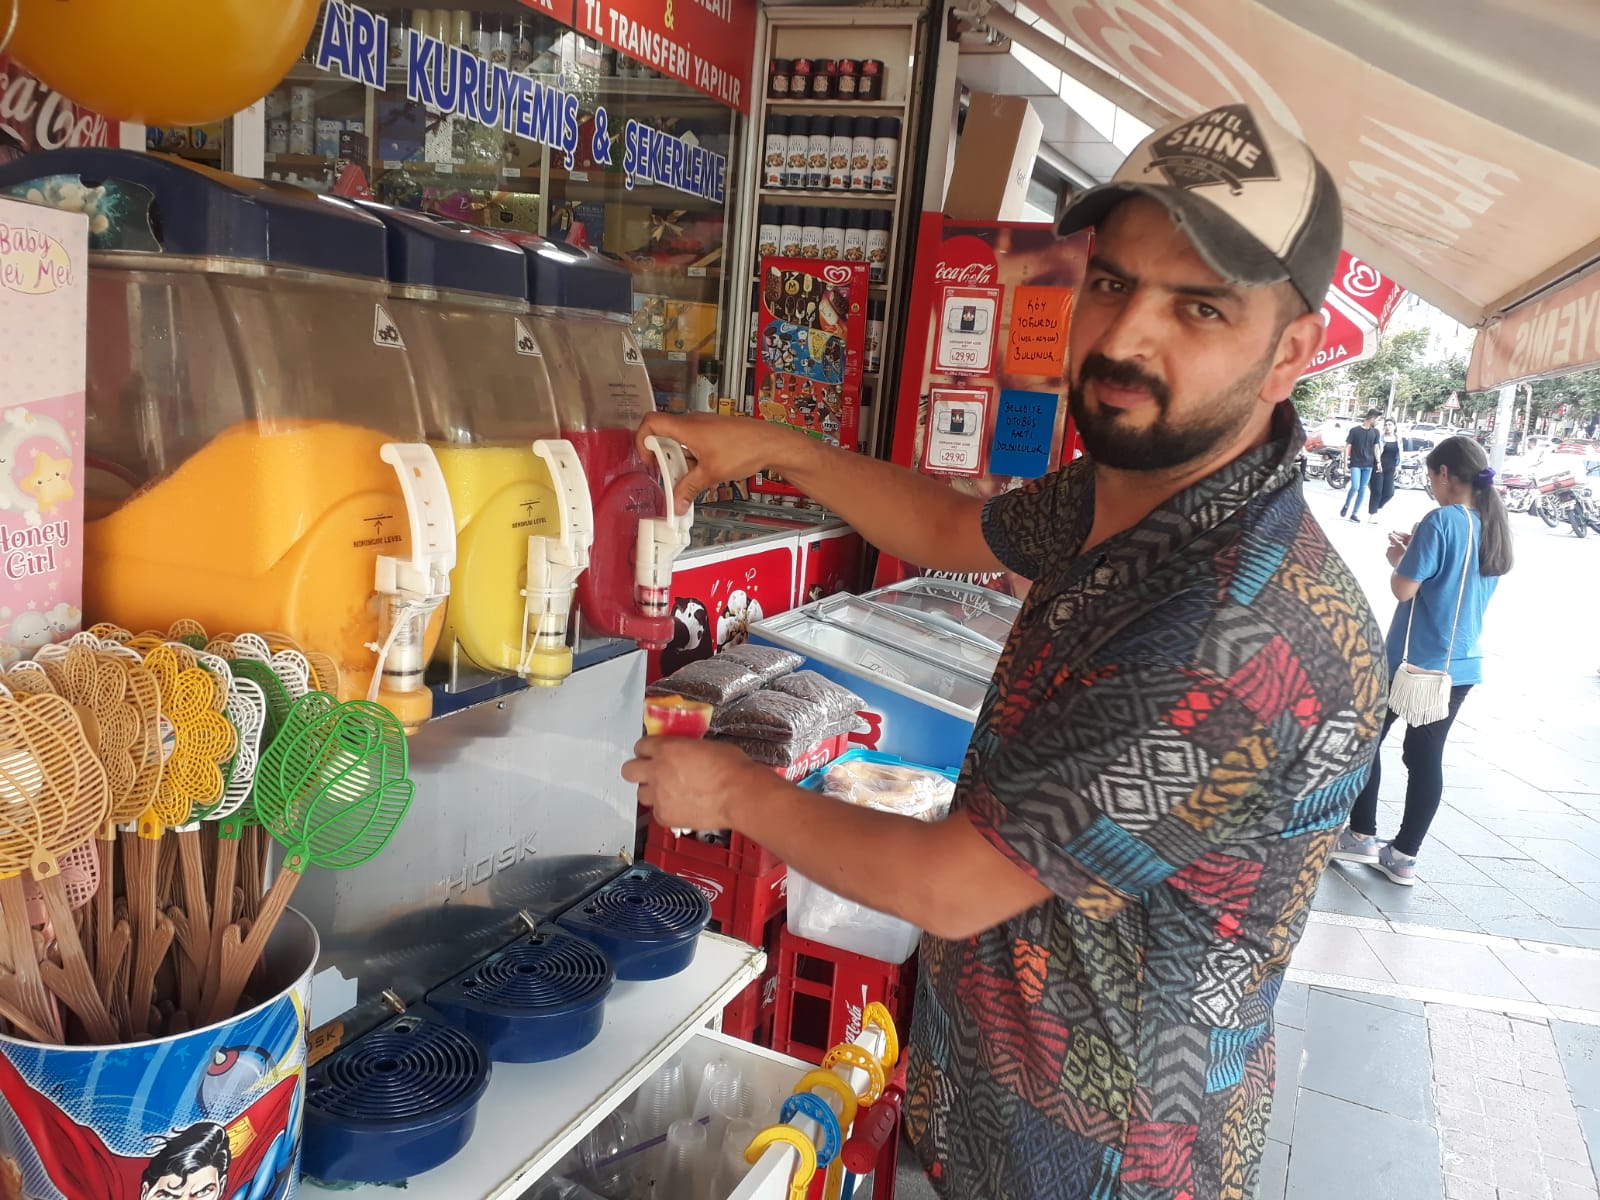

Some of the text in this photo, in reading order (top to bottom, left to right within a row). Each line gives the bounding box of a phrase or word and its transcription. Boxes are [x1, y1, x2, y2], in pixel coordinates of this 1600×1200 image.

[664, 0, 674, 31] &
[585, 0, 740, 106] TL TRANSFERİ YAPILIR
[316, 0, 727, 204] ARI KURUYEMİŞ & ŞEKERLEME
[1166, 124, 1262, 169] SHINE
[0, 223, 51, 259] Baby
[33, 259, 73, 289] Mei
[935, 261, 996, 284] Coca-Cola
[533, 517, 548, 526] LEVEL
[384, 534, 403, 544] LEVEL
[6, 545, 56, 579] Girl
[439, 831, 537, 904] HOSK
